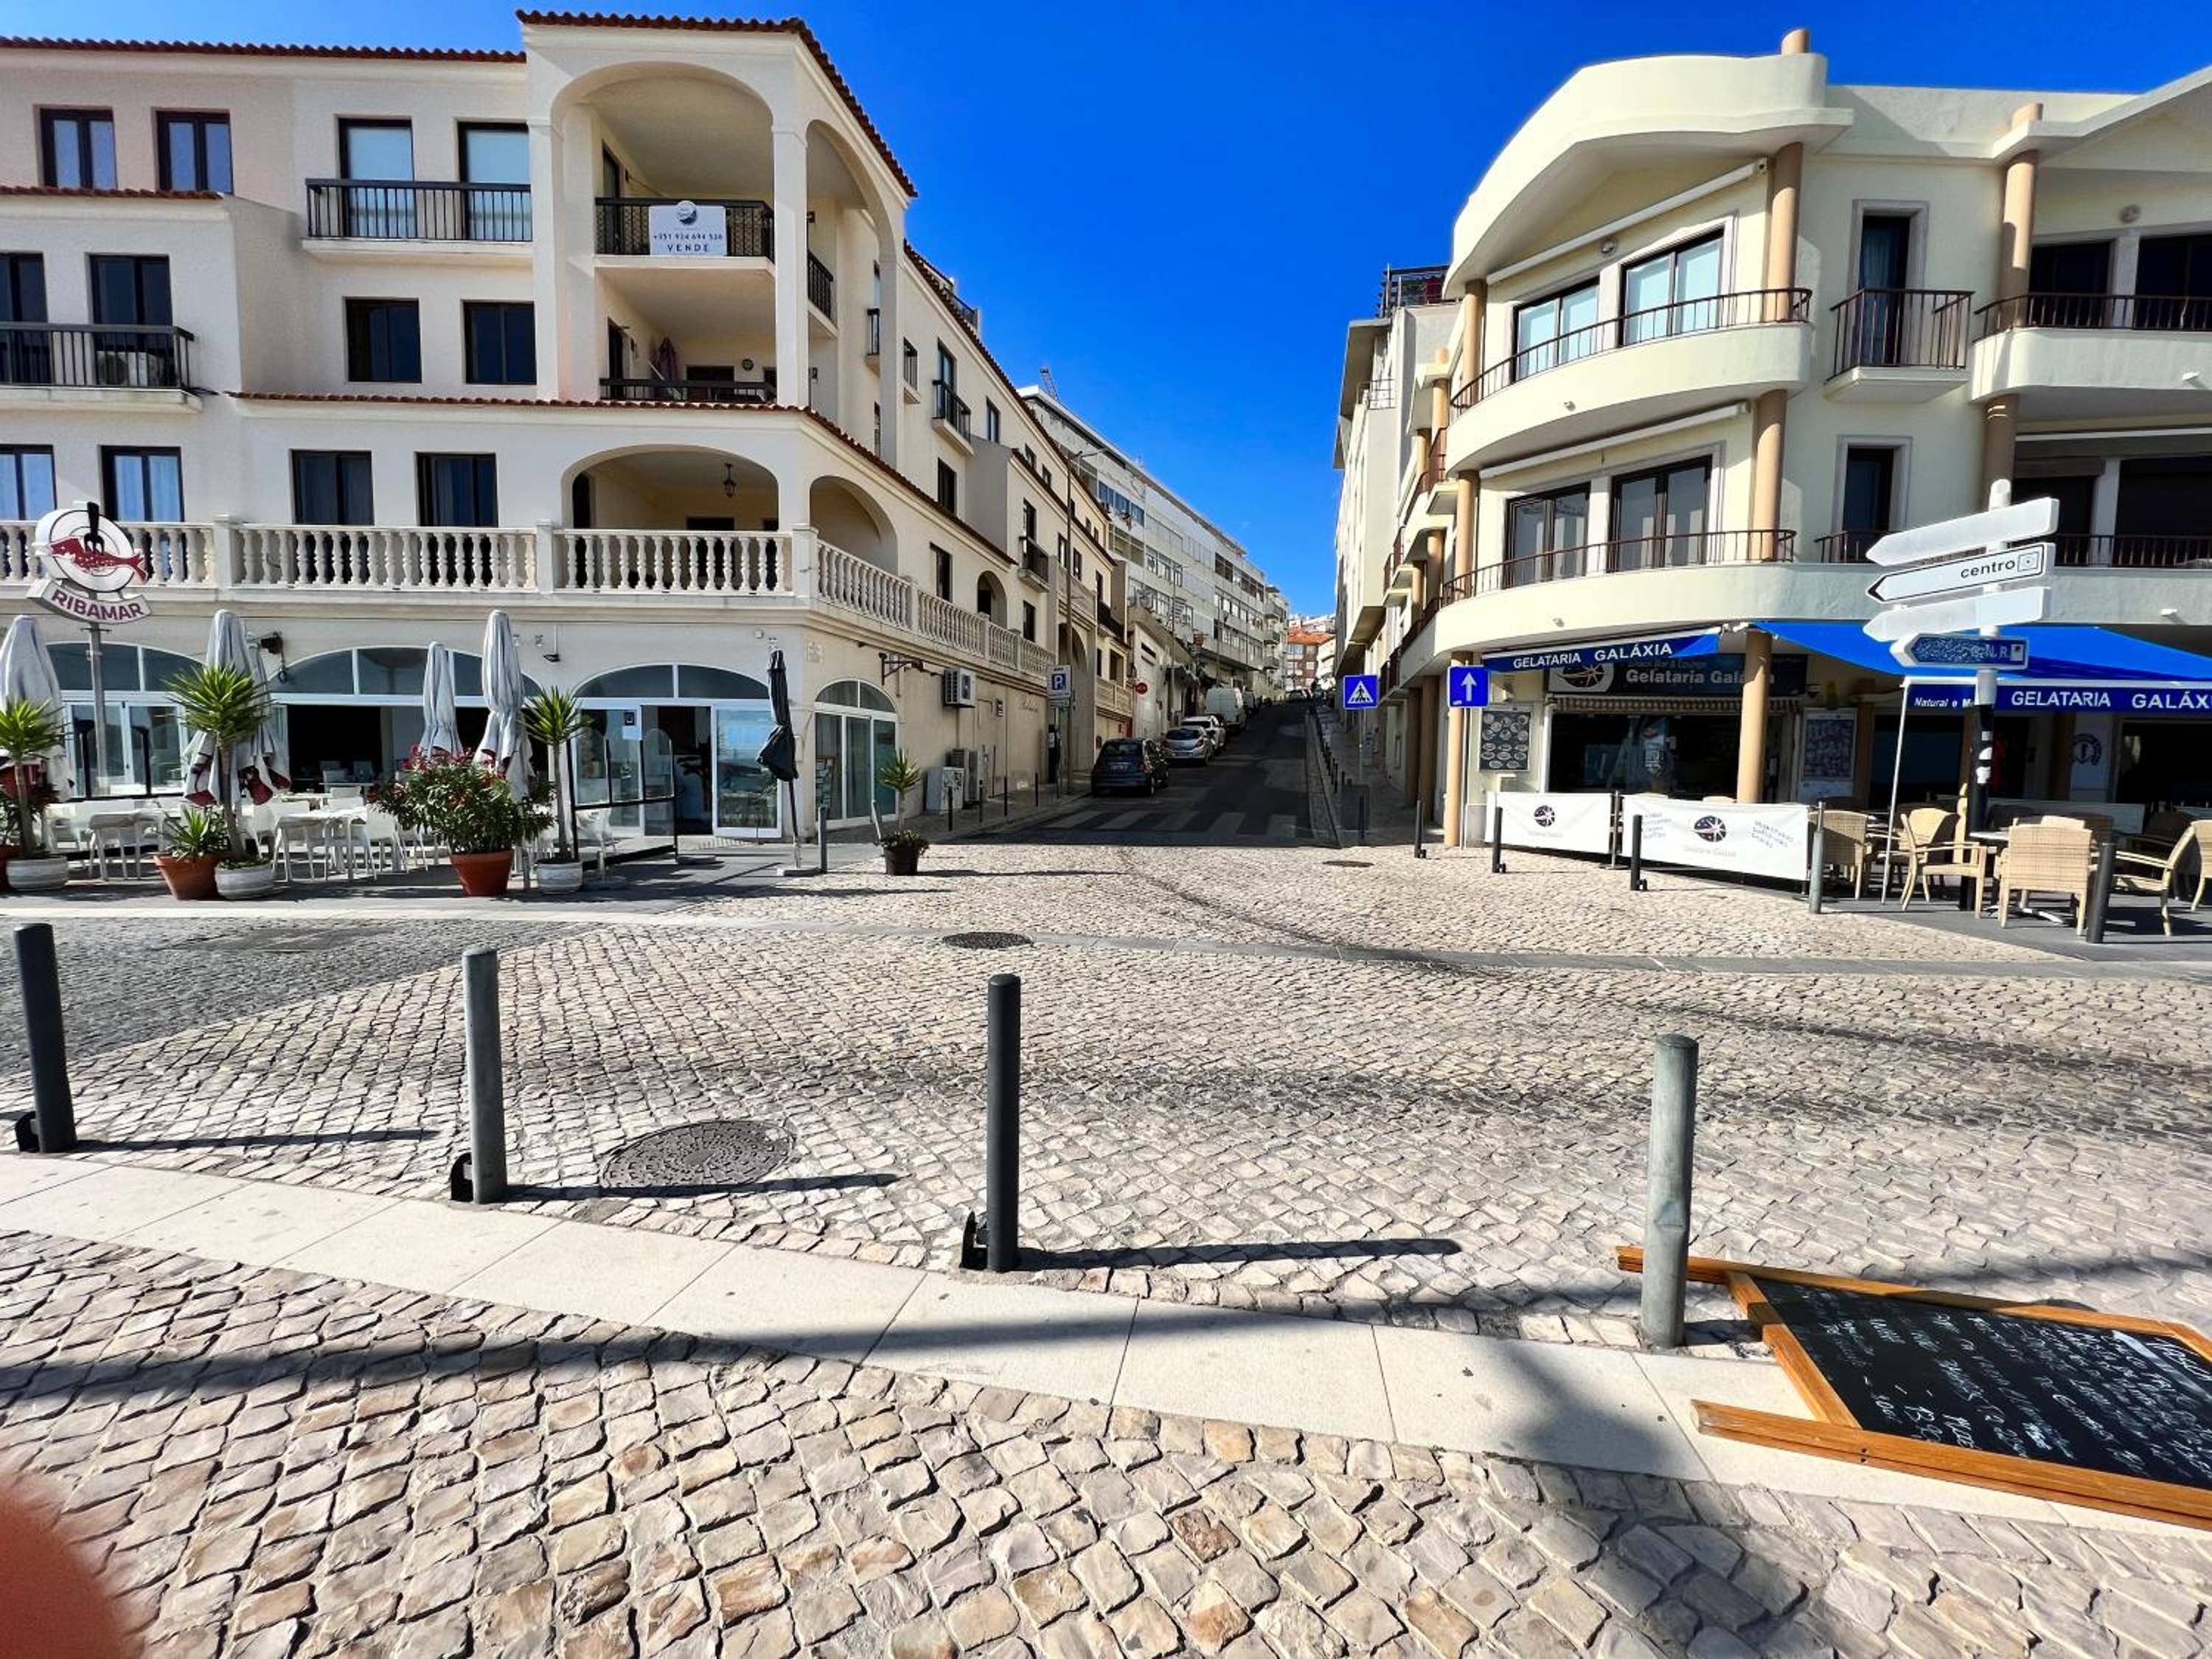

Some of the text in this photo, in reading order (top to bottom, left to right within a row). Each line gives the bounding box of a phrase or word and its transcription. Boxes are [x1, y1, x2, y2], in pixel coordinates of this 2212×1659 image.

[667, 244, 708, 252] VENDE
[1961, 560, 2015, 579] centro
[51, 589, 145, 620] RIBAMAR
[1513, 643, 1673, 669] GELATARIA GALÁXIA
[1626, 669, 1705, 684] Gelataria
[1914, 697, 1949, 707] Natural
[2011, 690, 2212, 709] GELATARIA GALÁX
